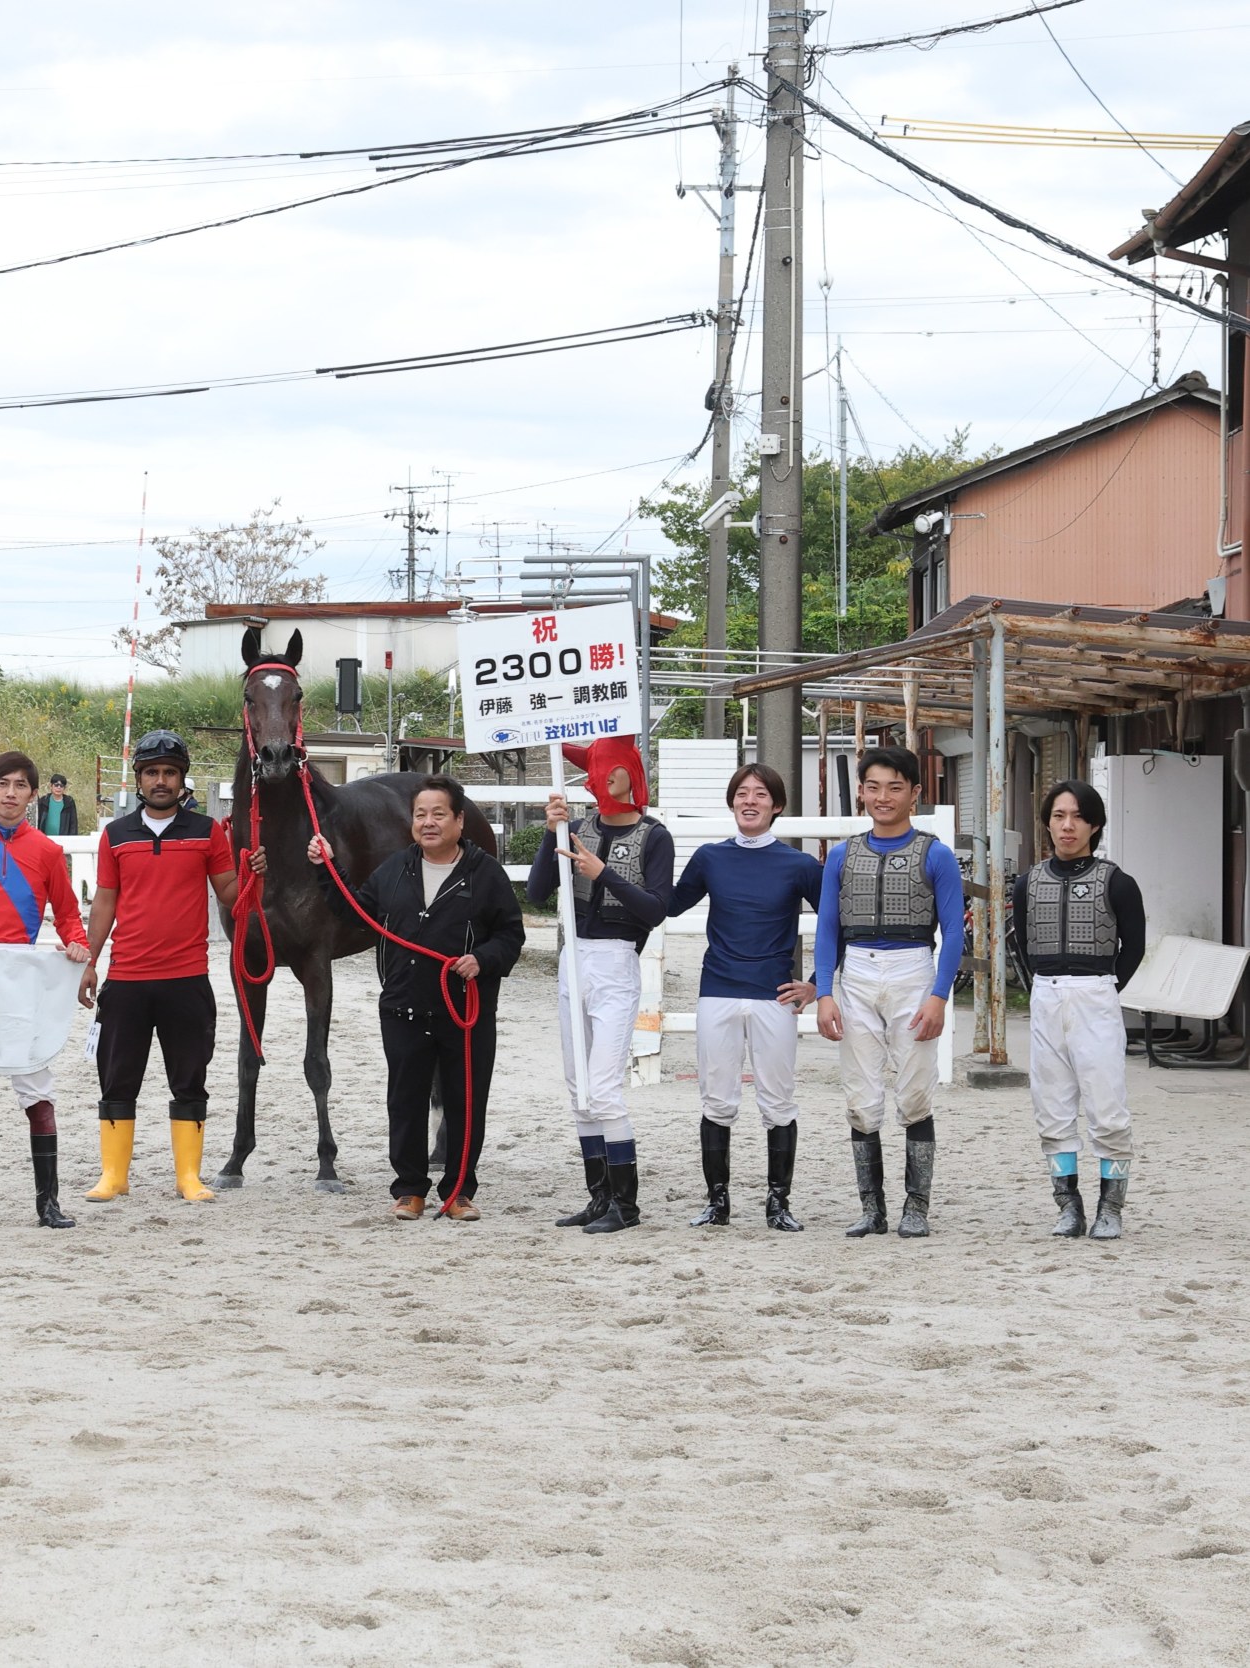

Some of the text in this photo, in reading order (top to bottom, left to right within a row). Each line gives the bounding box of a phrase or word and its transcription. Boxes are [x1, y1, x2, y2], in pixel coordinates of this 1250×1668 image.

[532, 616, 558, 643] 祝
[479, 681, 627, 716] 伊藤 強一 調教師
[545, 716, 621, 740] 笠松けいば
